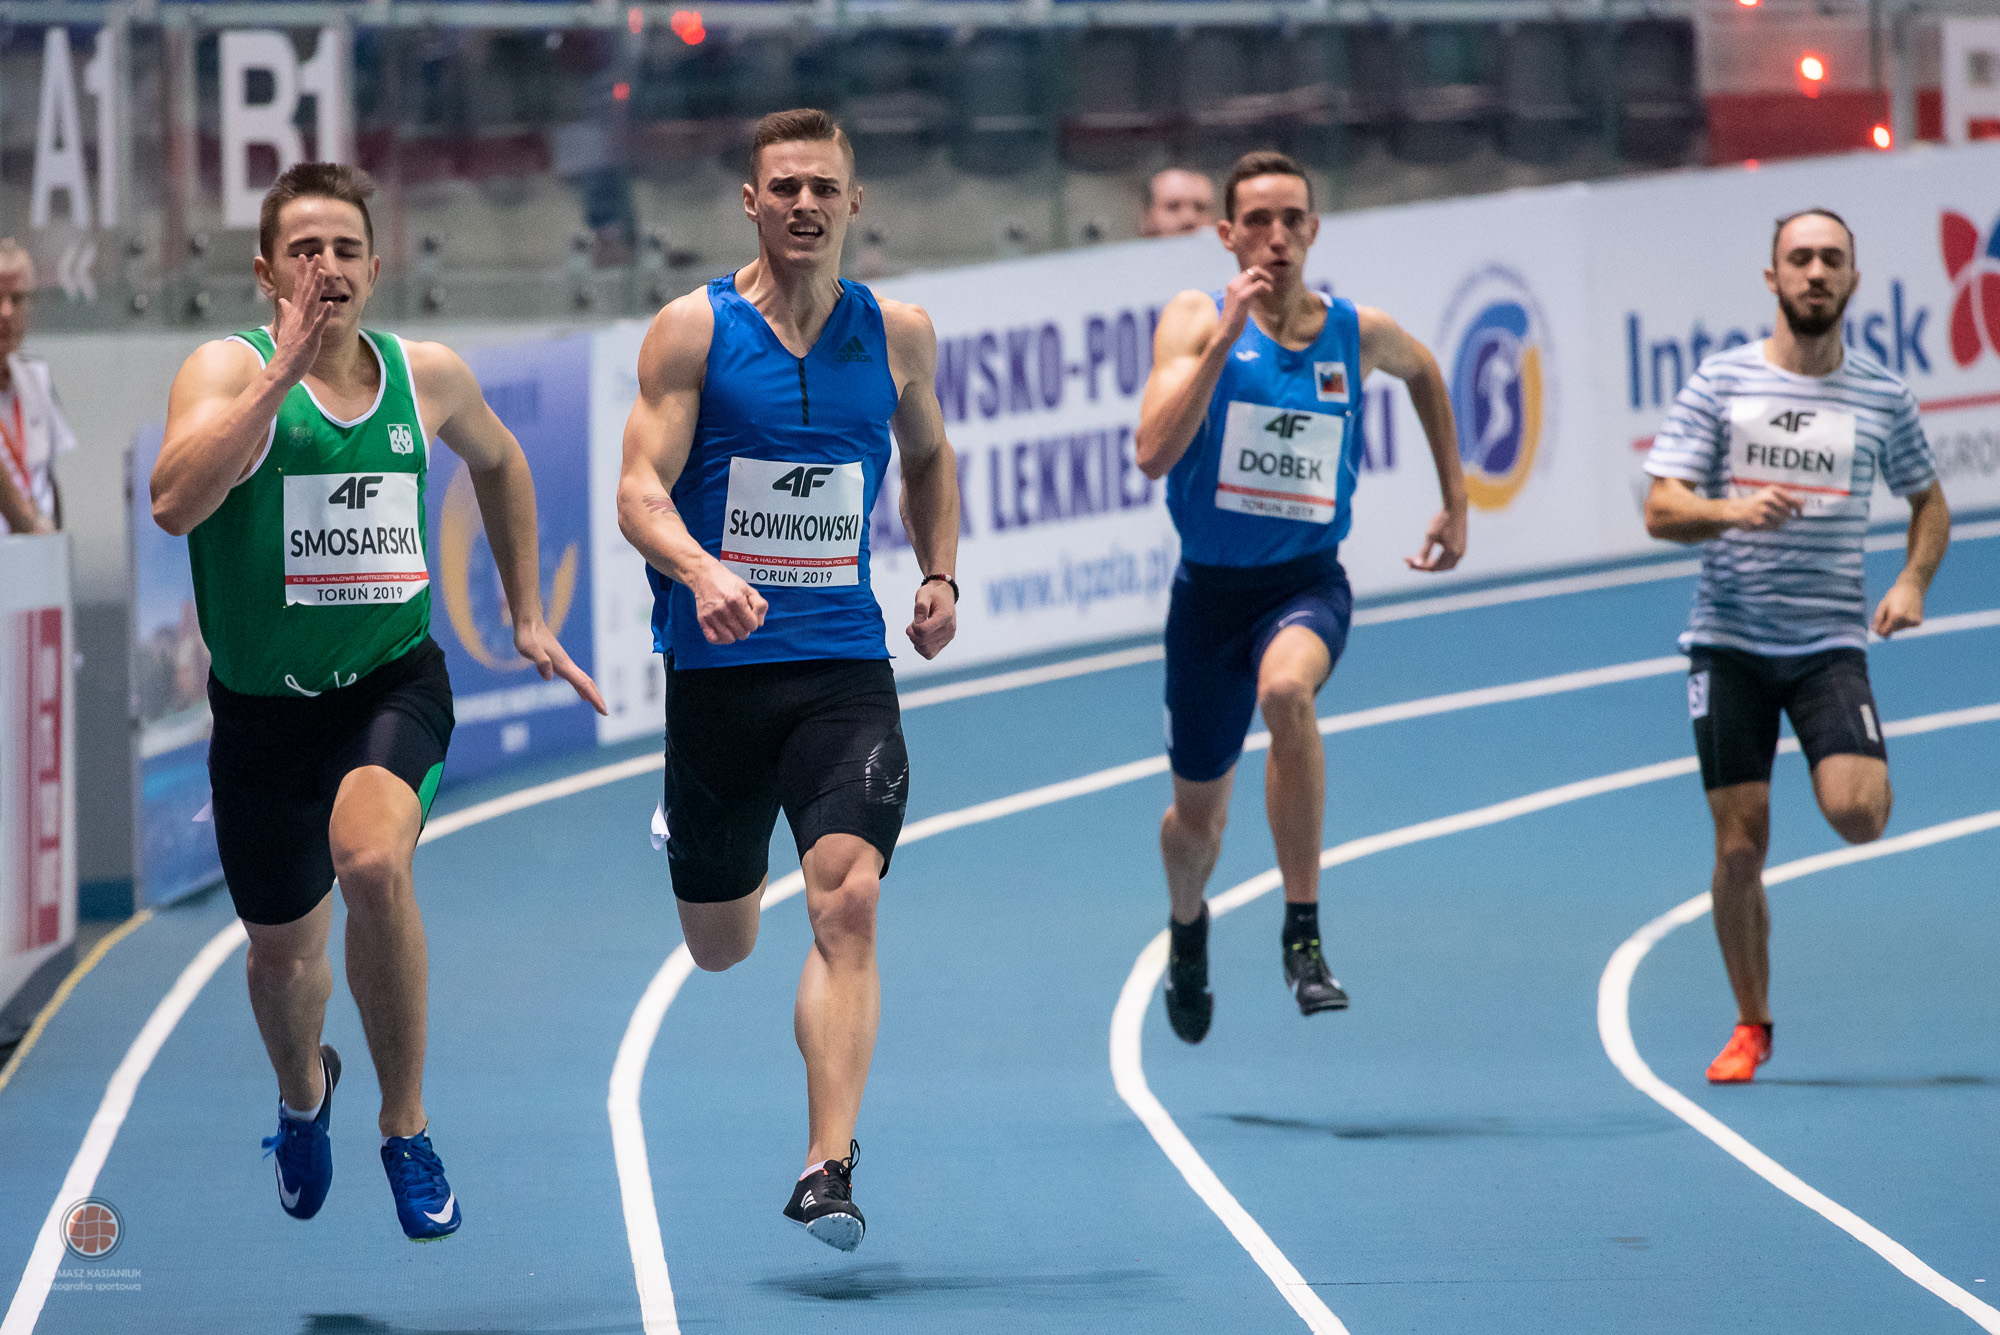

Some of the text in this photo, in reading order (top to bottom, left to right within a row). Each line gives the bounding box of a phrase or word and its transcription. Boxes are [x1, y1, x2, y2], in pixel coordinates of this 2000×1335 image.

[30, 26, 118, 230] A1
[217, 27, 346, 230] B1
[1264, 413, 1312, 439] 4F
[1768, 409, 1818, 433] 4F
[1239, 448, 1322, 482] DOBEK
[1745, 443, 1835, 474] FIEDEŃ
[328, 475, 384, 510] 4F
[772, 465, 835, 498] 4F
[729, 508, 859, 542] SŁOWIKOWSKI
[290, 526, 418, 558] SMOSARSKI
[749, 567, 833, 583] TORUŃ 2019
[317, 583, 403, 601] TORUŃ 2019
